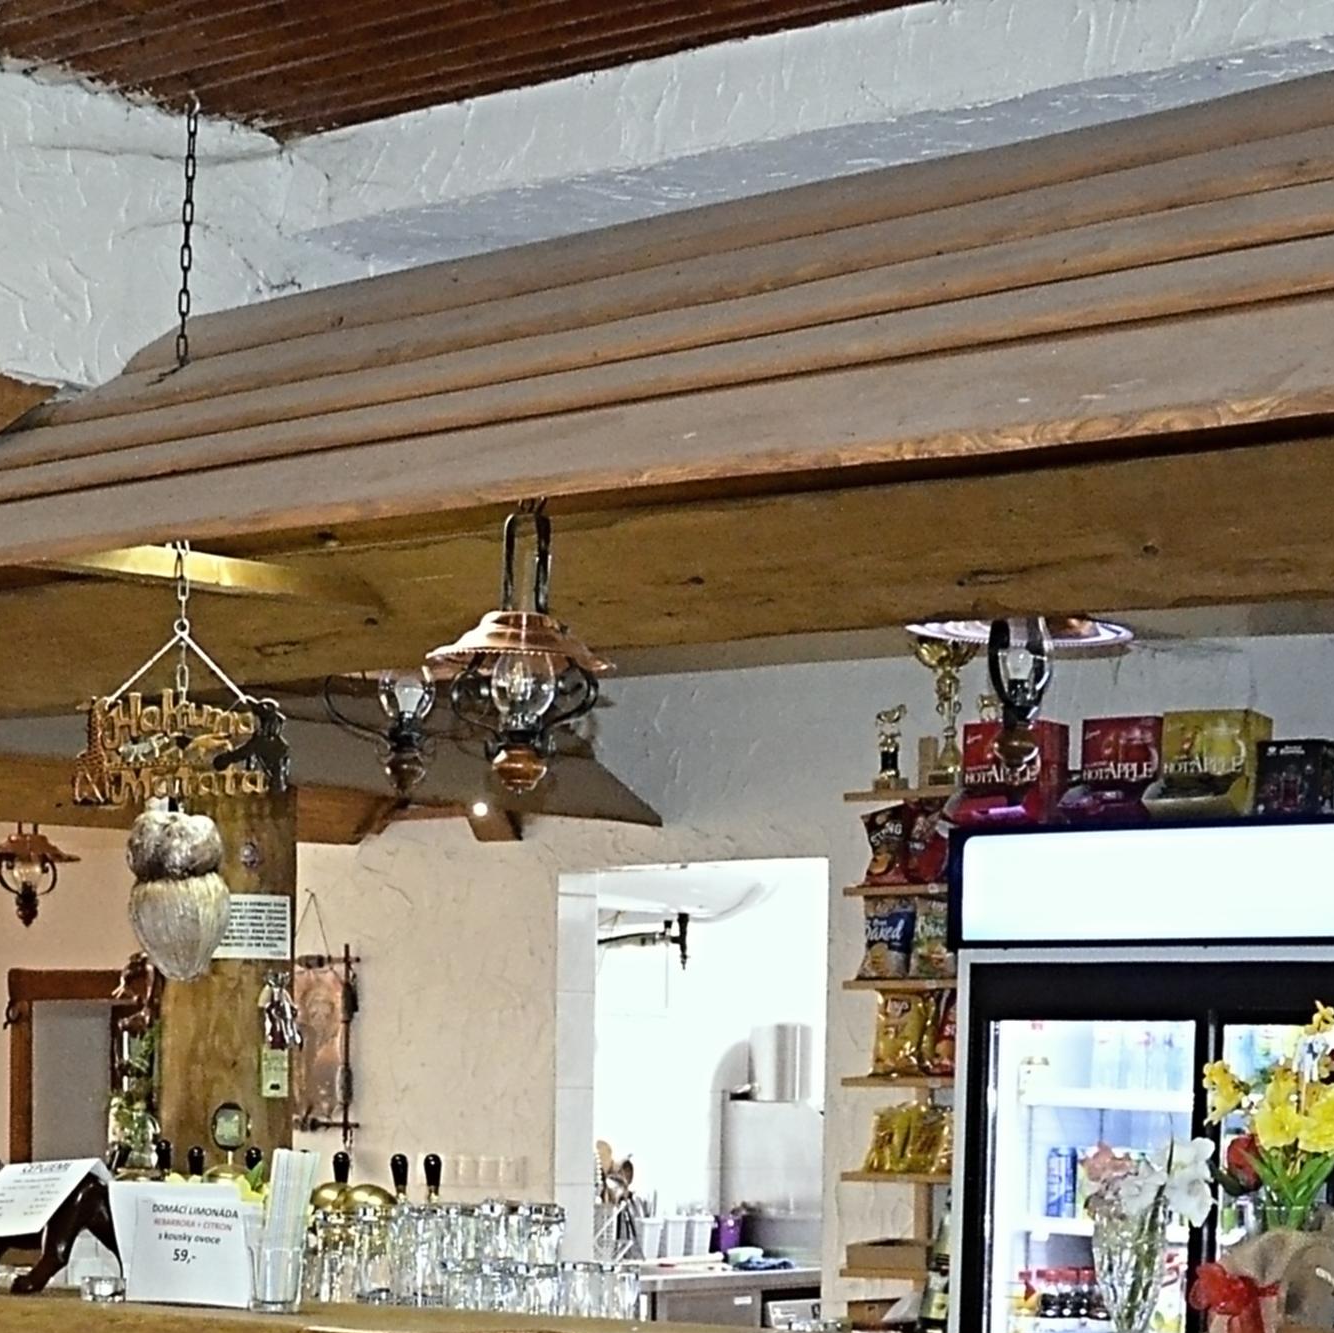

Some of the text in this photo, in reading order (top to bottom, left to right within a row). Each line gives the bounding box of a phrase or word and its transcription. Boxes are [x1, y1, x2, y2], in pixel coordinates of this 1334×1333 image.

[152, 1203, 239, 1219] DOMÁCÍ LIMONÁDA
[203, 1222, 233, 1232] CITRON
[164, 1231, 192, 1243] kousky
[194, 1235, 222, 1244] ovoce
[172, 1248, 197, 1264] 59,-
